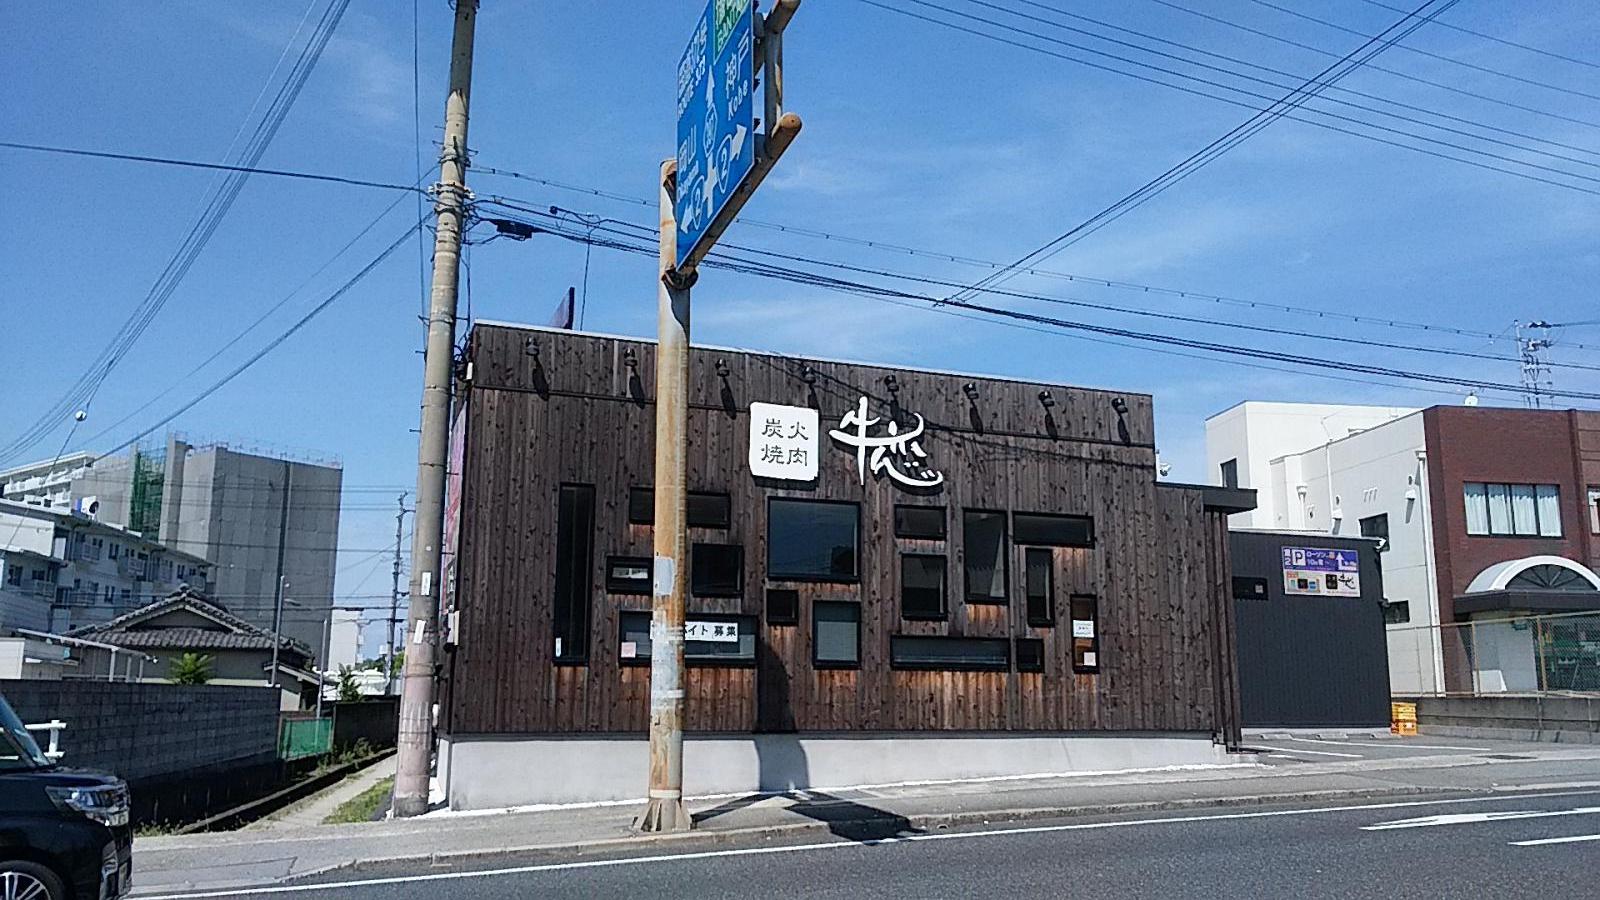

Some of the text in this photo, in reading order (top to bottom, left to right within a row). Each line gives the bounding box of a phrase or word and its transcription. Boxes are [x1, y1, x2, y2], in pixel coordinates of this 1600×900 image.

[725, 27, 749, 100] 神戸
[727, 79, 748, 121] Kobe
[678, 124, 697, 181] 岡山
[721, 147, 728, 180] 2
[695, 187, 701, 218] 2
[761, 418, 809, 441] 炭火
[760, 443, 808, 467] 焼肉
